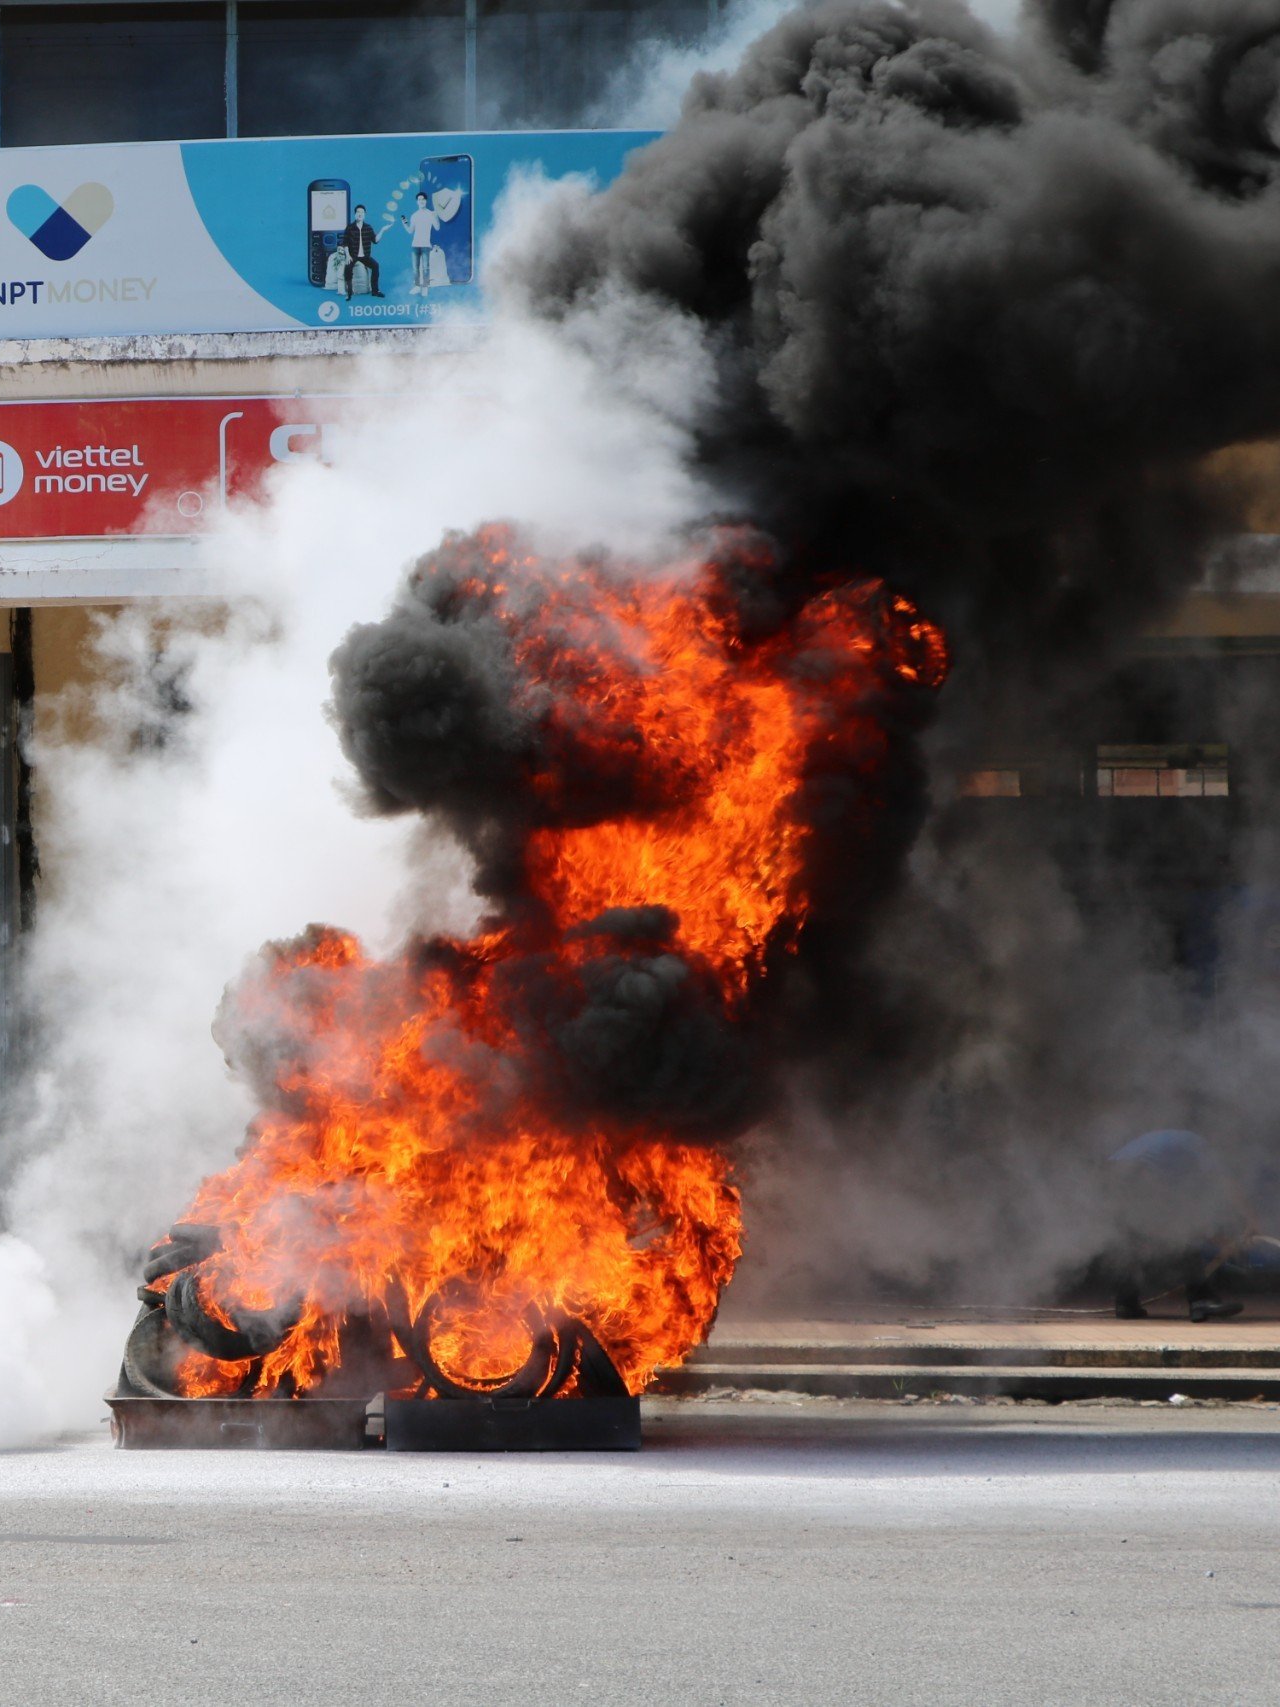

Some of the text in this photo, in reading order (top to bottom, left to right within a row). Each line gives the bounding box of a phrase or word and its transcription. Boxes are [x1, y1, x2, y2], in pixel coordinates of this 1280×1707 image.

[348, 304, 410, 317] 18001091
[35, 445, 144, 468] viettel
[35, 473, 149, 497] money
